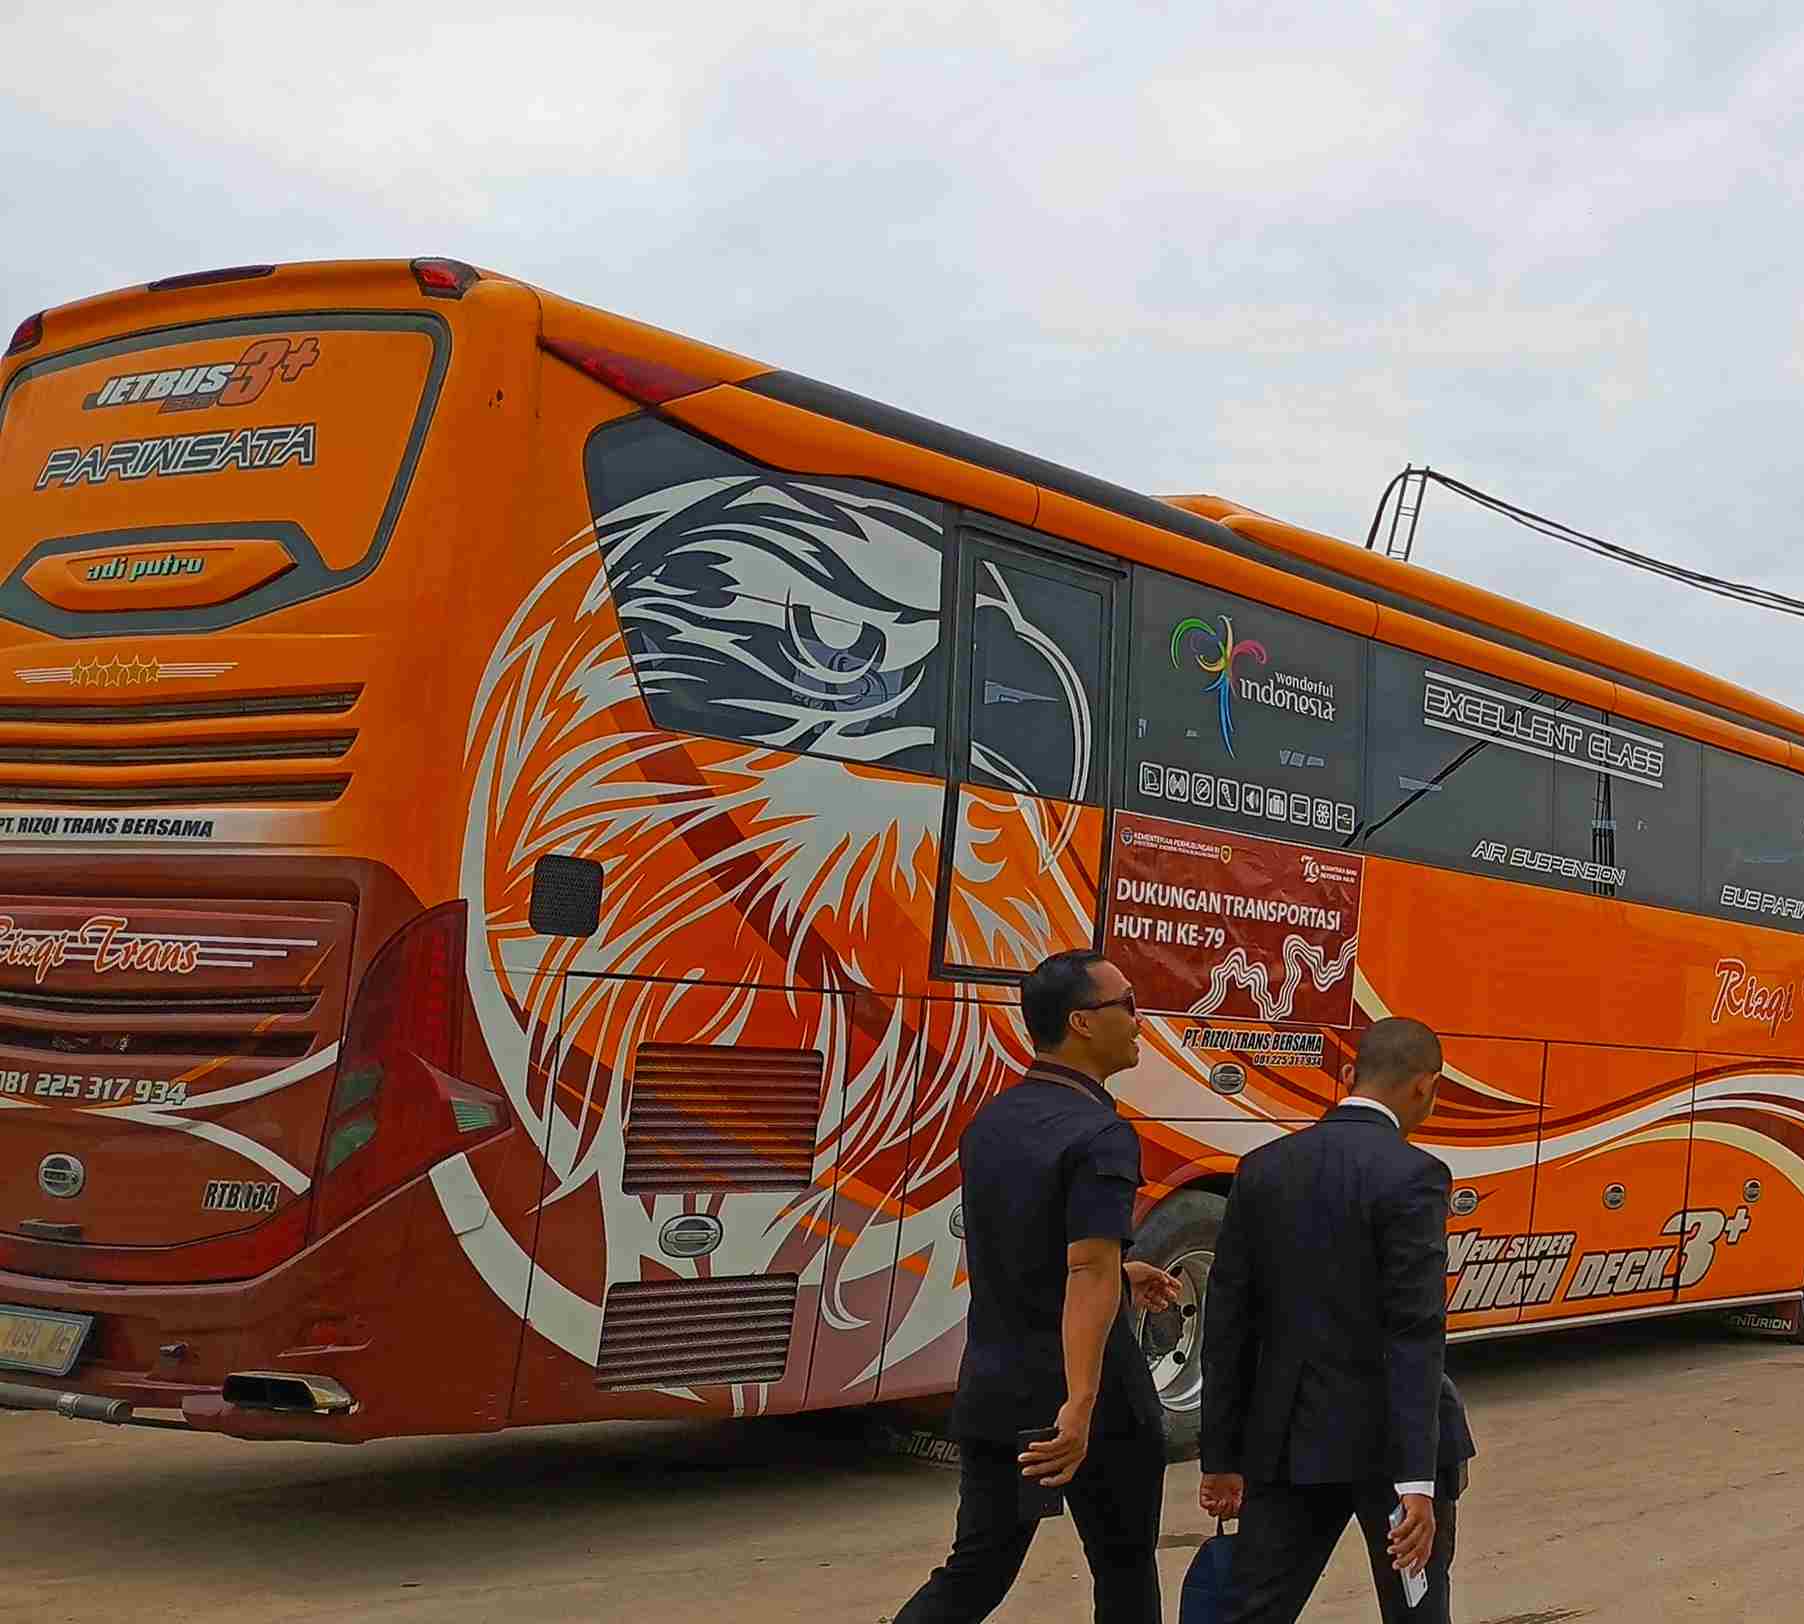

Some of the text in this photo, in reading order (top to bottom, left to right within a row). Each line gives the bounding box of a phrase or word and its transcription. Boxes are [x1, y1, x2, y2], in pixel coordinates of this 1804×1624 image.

[34, 423, 316, 490] PARIWISATA
[87, 557, 128, 582] adi
[1424, 684, 1664, 777] EXCELLENT CLASS
[17, 816, 60, 835] RIZQI
[63, 816, 119, 835] TRANS
[120, 817, 214, 838] BERSAMA
[1472, 841, 1627, 887] AIR SUSPENSION
[1116, 878, 1342, 931] DUKUNGAN TRANSPORTASI
[1720, 884, 1760, 913] BUS
[80, 915, 200, 974] Trans
[1113, 913, 1225, 949] HUT RI KE-79
[1711, 958, 1795, 1040] Rizqi
[1182, 1029, 1323, 1053] PT. RIZQI TRANS BERSAMA
[33, 1072, 83, 1098] 225
[84, 1076, 131, 1101] 317
[135, 1079, 189, 1105] 934
[1504, 1233, 1575, 1259] SUPER
[1446, 1258, 1567, 1312] HIGH
